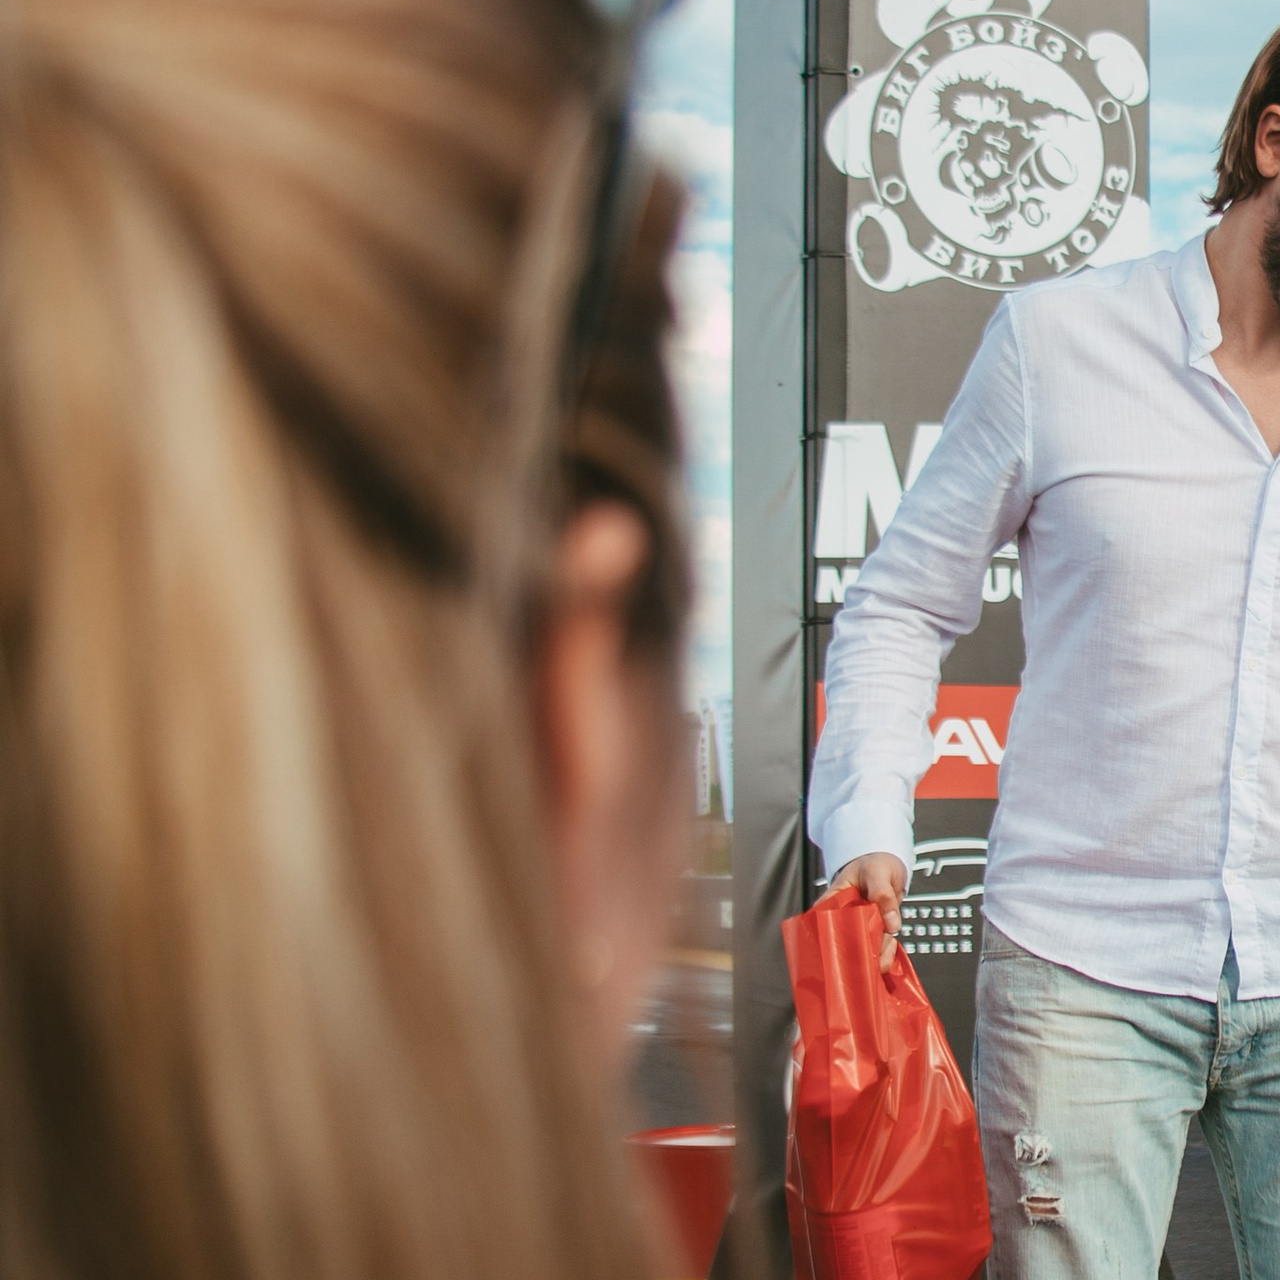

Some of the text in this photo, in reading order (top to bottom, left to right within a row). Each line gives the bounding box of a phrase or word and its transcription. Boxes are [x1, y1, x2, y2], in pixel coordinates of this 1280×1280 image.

[877, 47, 931, 137] БИГ
[923, 166, 1130, 283] БИГ ТОЙЗ
[893, 923, 973, 937] ТОВЫХ
[901, 904, 973, 919] МУЗЕЙ
